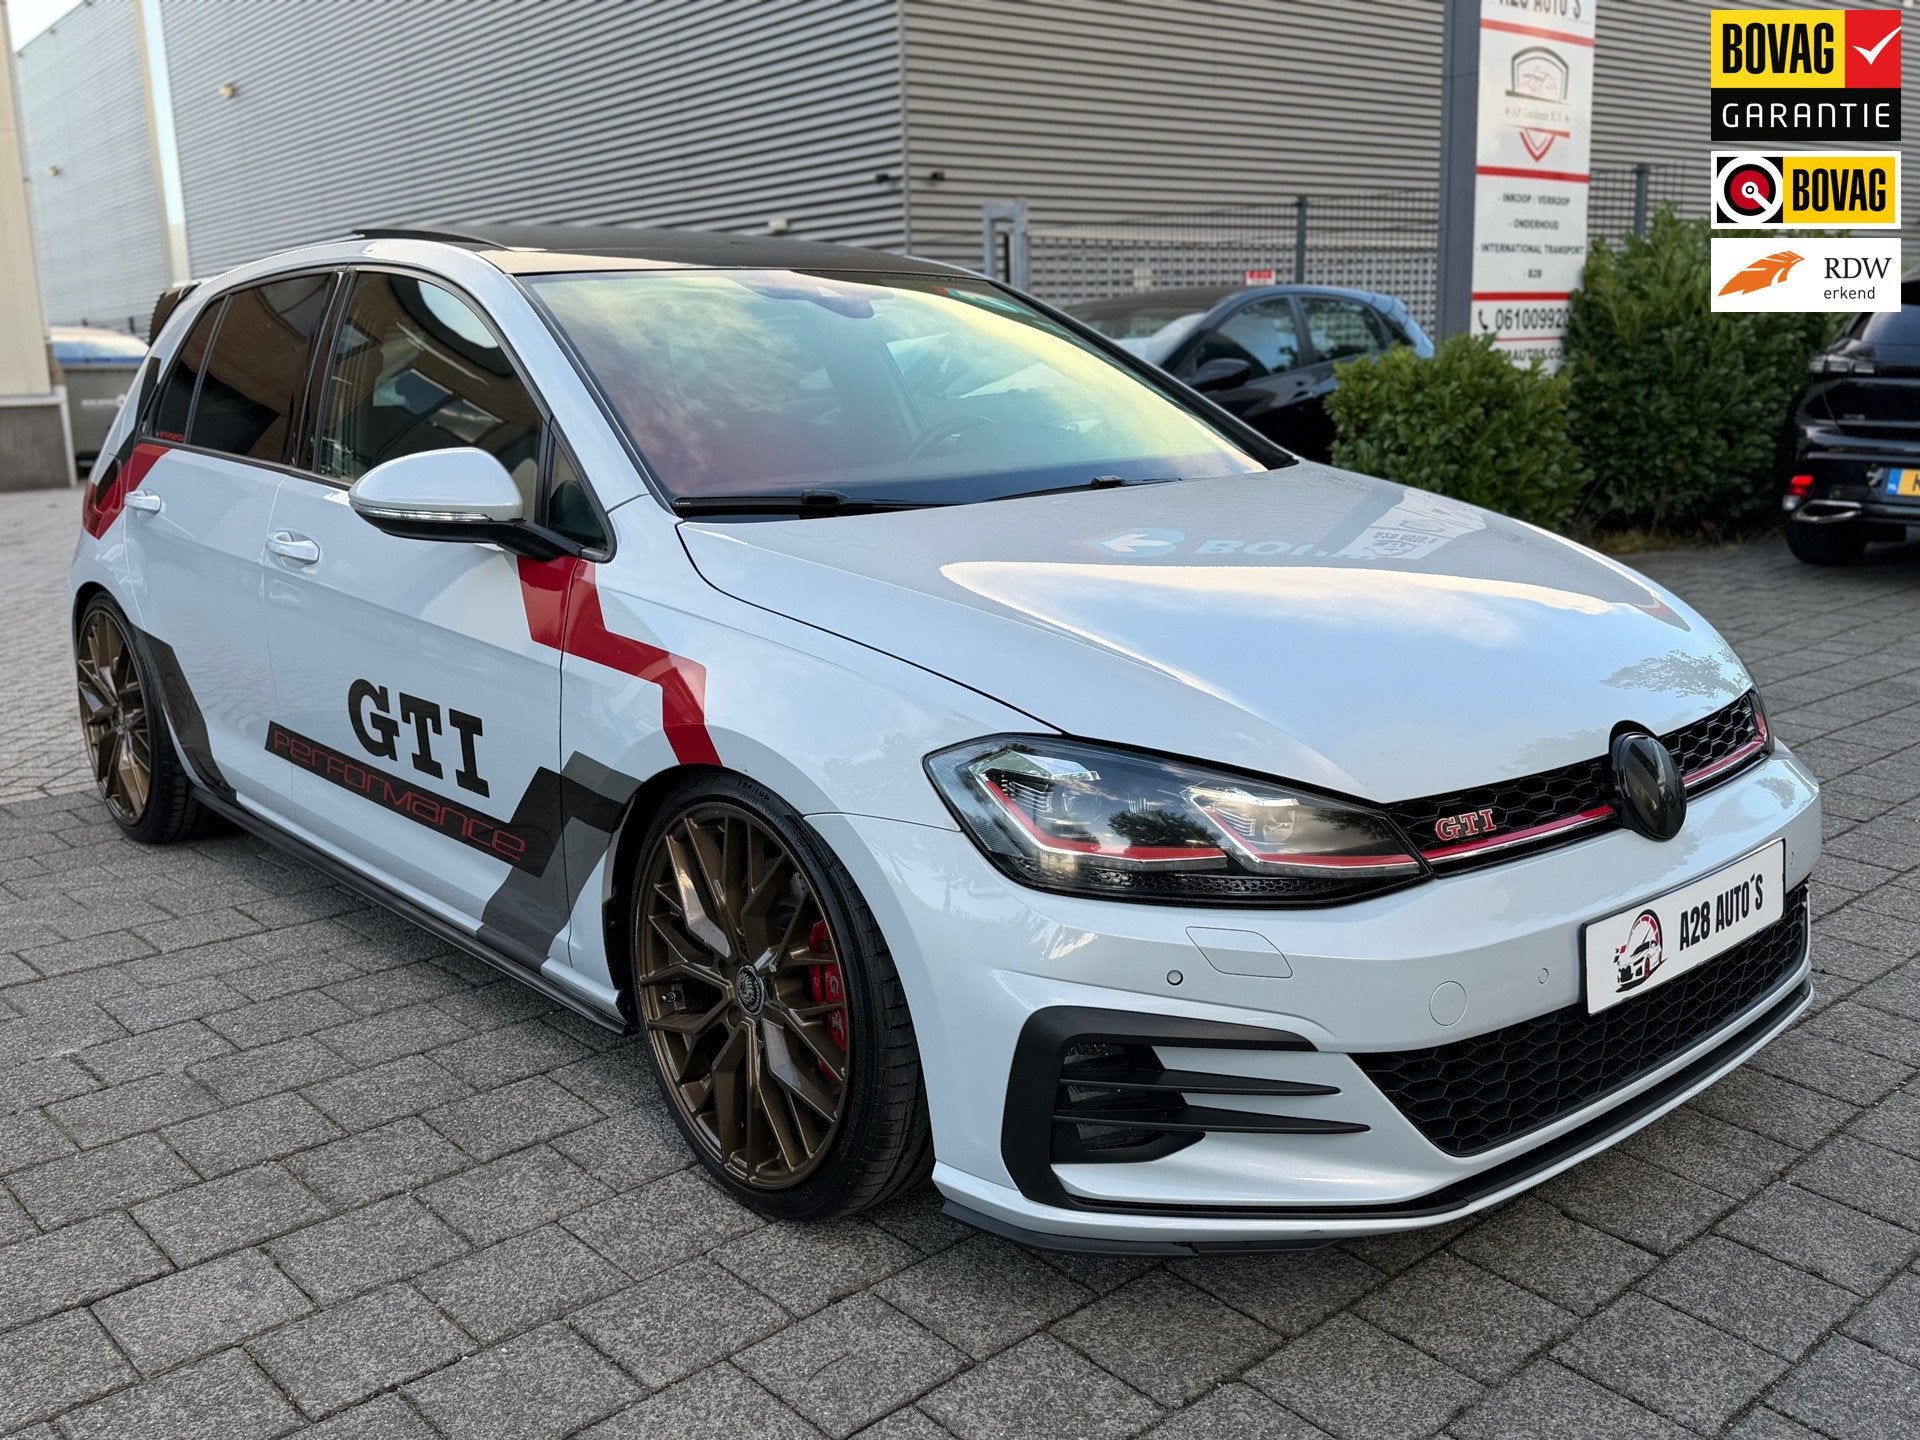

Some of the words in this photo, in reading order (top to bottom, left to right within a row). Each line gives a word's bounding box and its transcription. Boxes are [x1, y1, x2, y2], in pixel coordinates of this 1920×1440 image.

[1513, 219, 1559, 230] ONDERHOUD
[1481, 243, 1542, 254] INTERNATIONAL
[1544, 244, 1584, 255] TRANSPORT
[348, 678, 490, 798] GTI
[1435, 808, 1497, 842] GTI
[1679, 900, 1710, 951] A28
